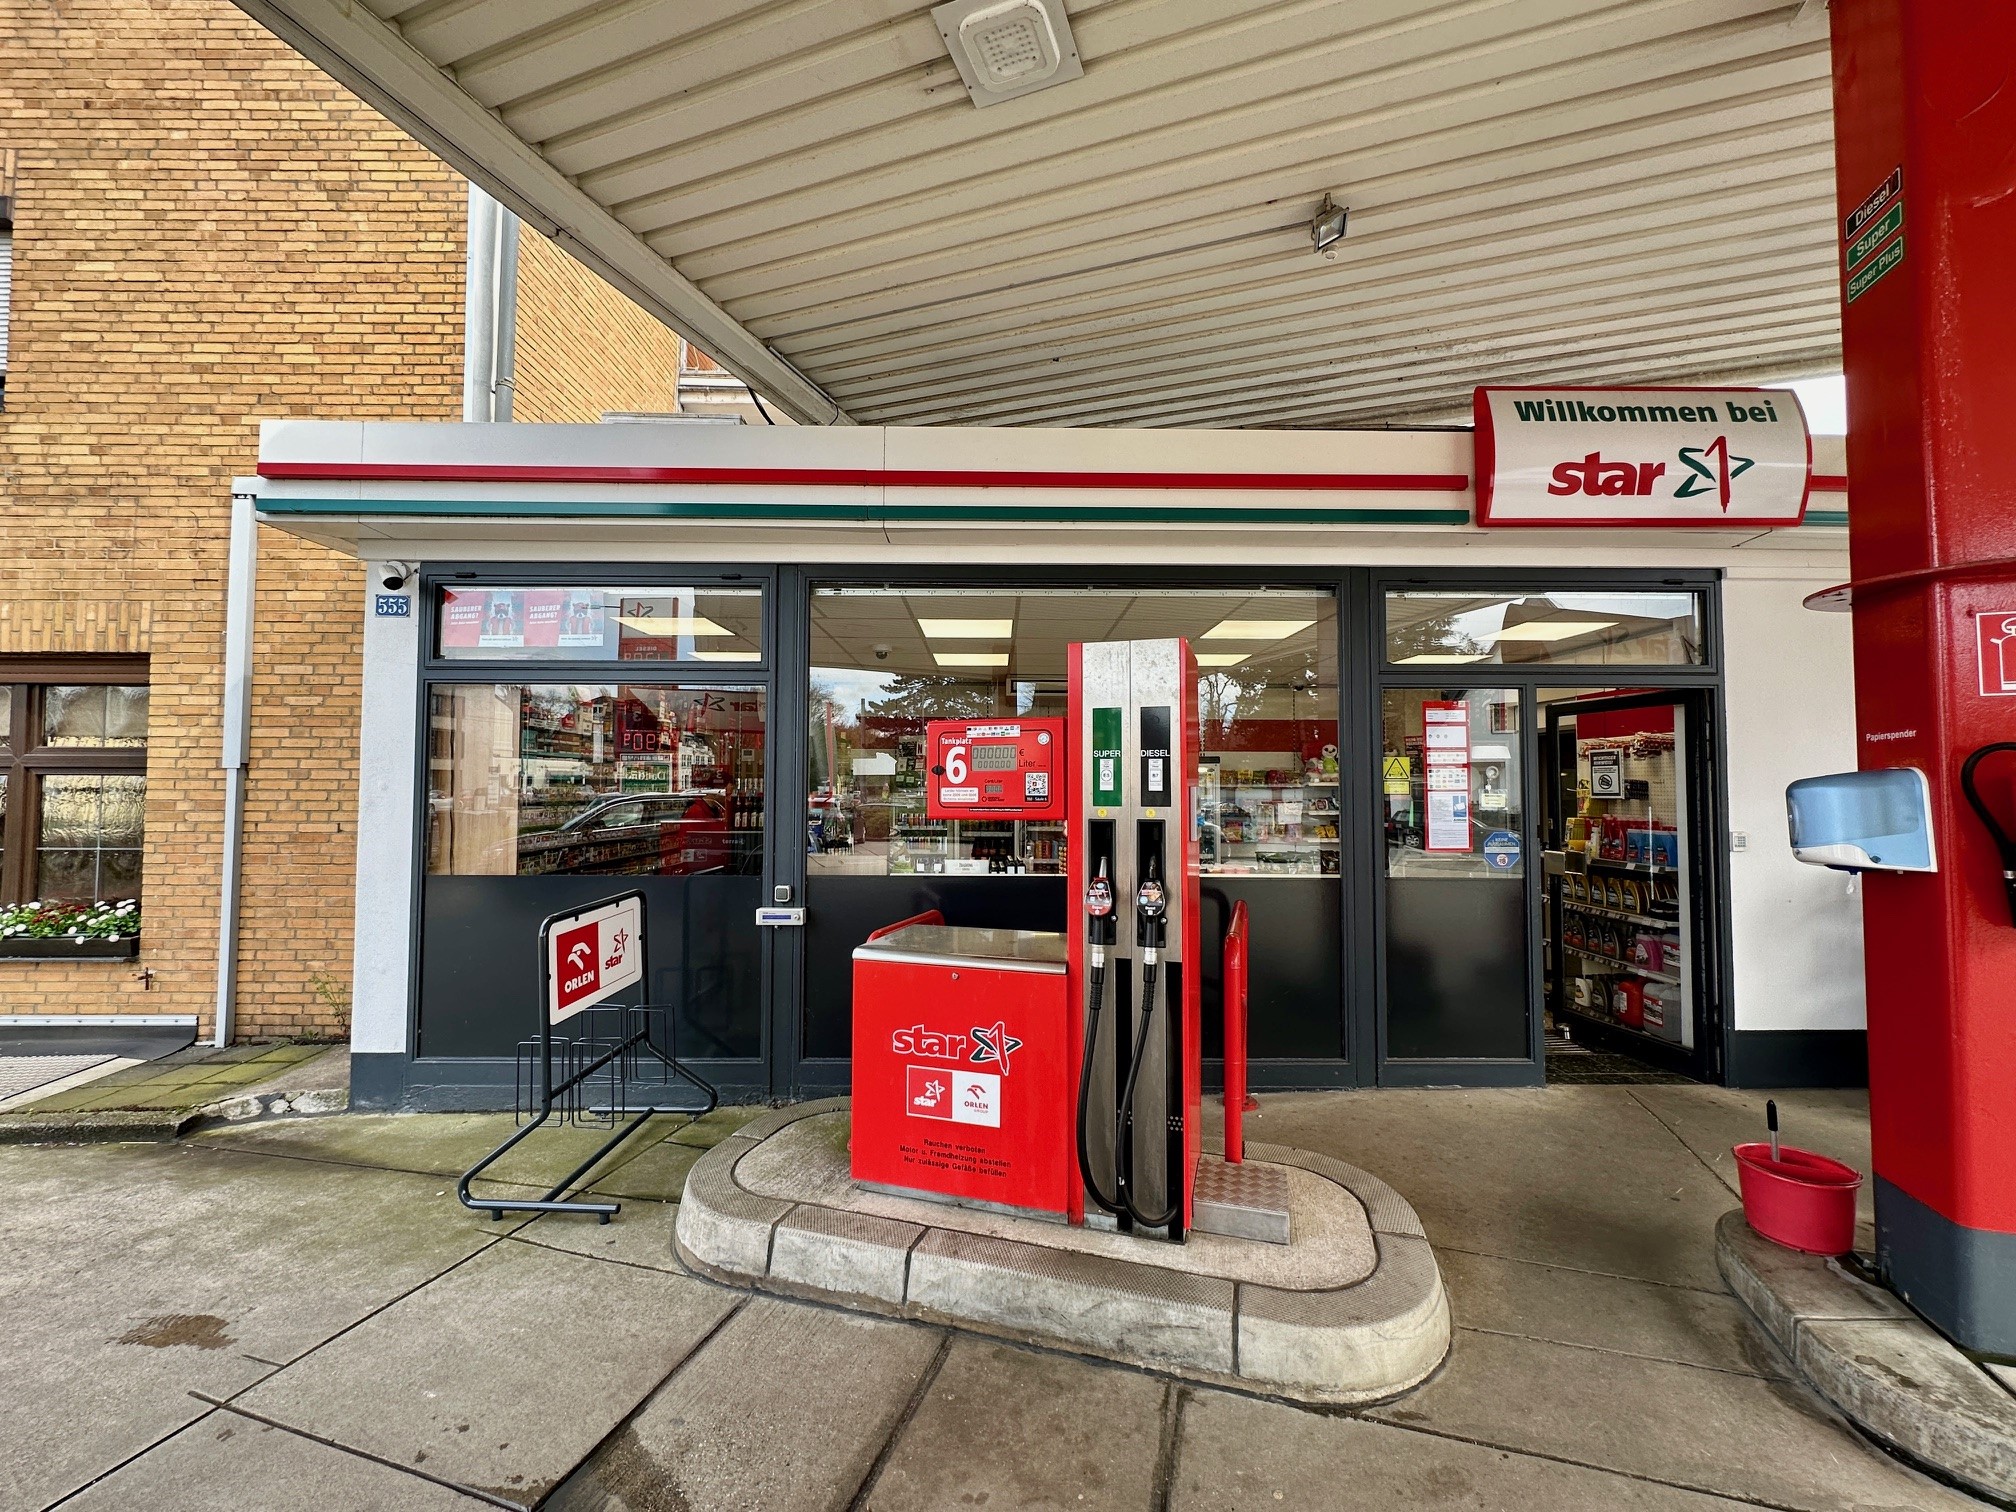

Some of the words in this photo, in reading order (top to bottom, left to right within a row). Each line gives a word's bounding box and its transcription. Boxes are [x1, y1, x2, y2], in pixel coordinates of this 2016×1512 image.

[1855, 183, 1890, 227] Diesel
[1857, 218, 1891, 257] Super
[1850, 266, 1878, 295] Super
[1879, 246, 1900, 270] Plus
[1513, 398, 1719, 423] Willkommen
[1725, 399, 1778, 423] bei
[1547, 451, 1666, 497] star
[378, 598, 408, 614] 555
[451, 605, 482, 613] SAUBERER
[529, 604, 561, 612] SAUBERER
[450, 612, 479, 620] ABGANG?
[941, 737, 973, 745] Tankplatz
[1865, 729, 1917, 742] Papierspender
[1093, 749, 1121, 758] SUPER
[1140, 749, 1170, 757] DIESEL
[945, 746, 967, 784] 6
[1018, 759, 1036, 768] Liter
[604, 953, 623, 970] star
[564, 969, 595, 993] ORLEN
[892, 1024, 967, 1060] star
[914, 1095, 937, 1108] star
[964, 1100, 989, 1110] ORLEN
[923, 1138, 952, 1149] Rauchen
[955, 1144, 986, 1154] verboten
[899, 1145, 919, 1154] Motor
[930, 1149, 977, 1164] Fremdheizung
[979, 1157, 1011, 1168] abstellen
[903, 1155, 915, 1164] Nur
[918, 1157, 949, 1169] zulässige
[952, 1162, 977, 1173] Gefäße
[979, 1167, 1007, 1178] befüllen
